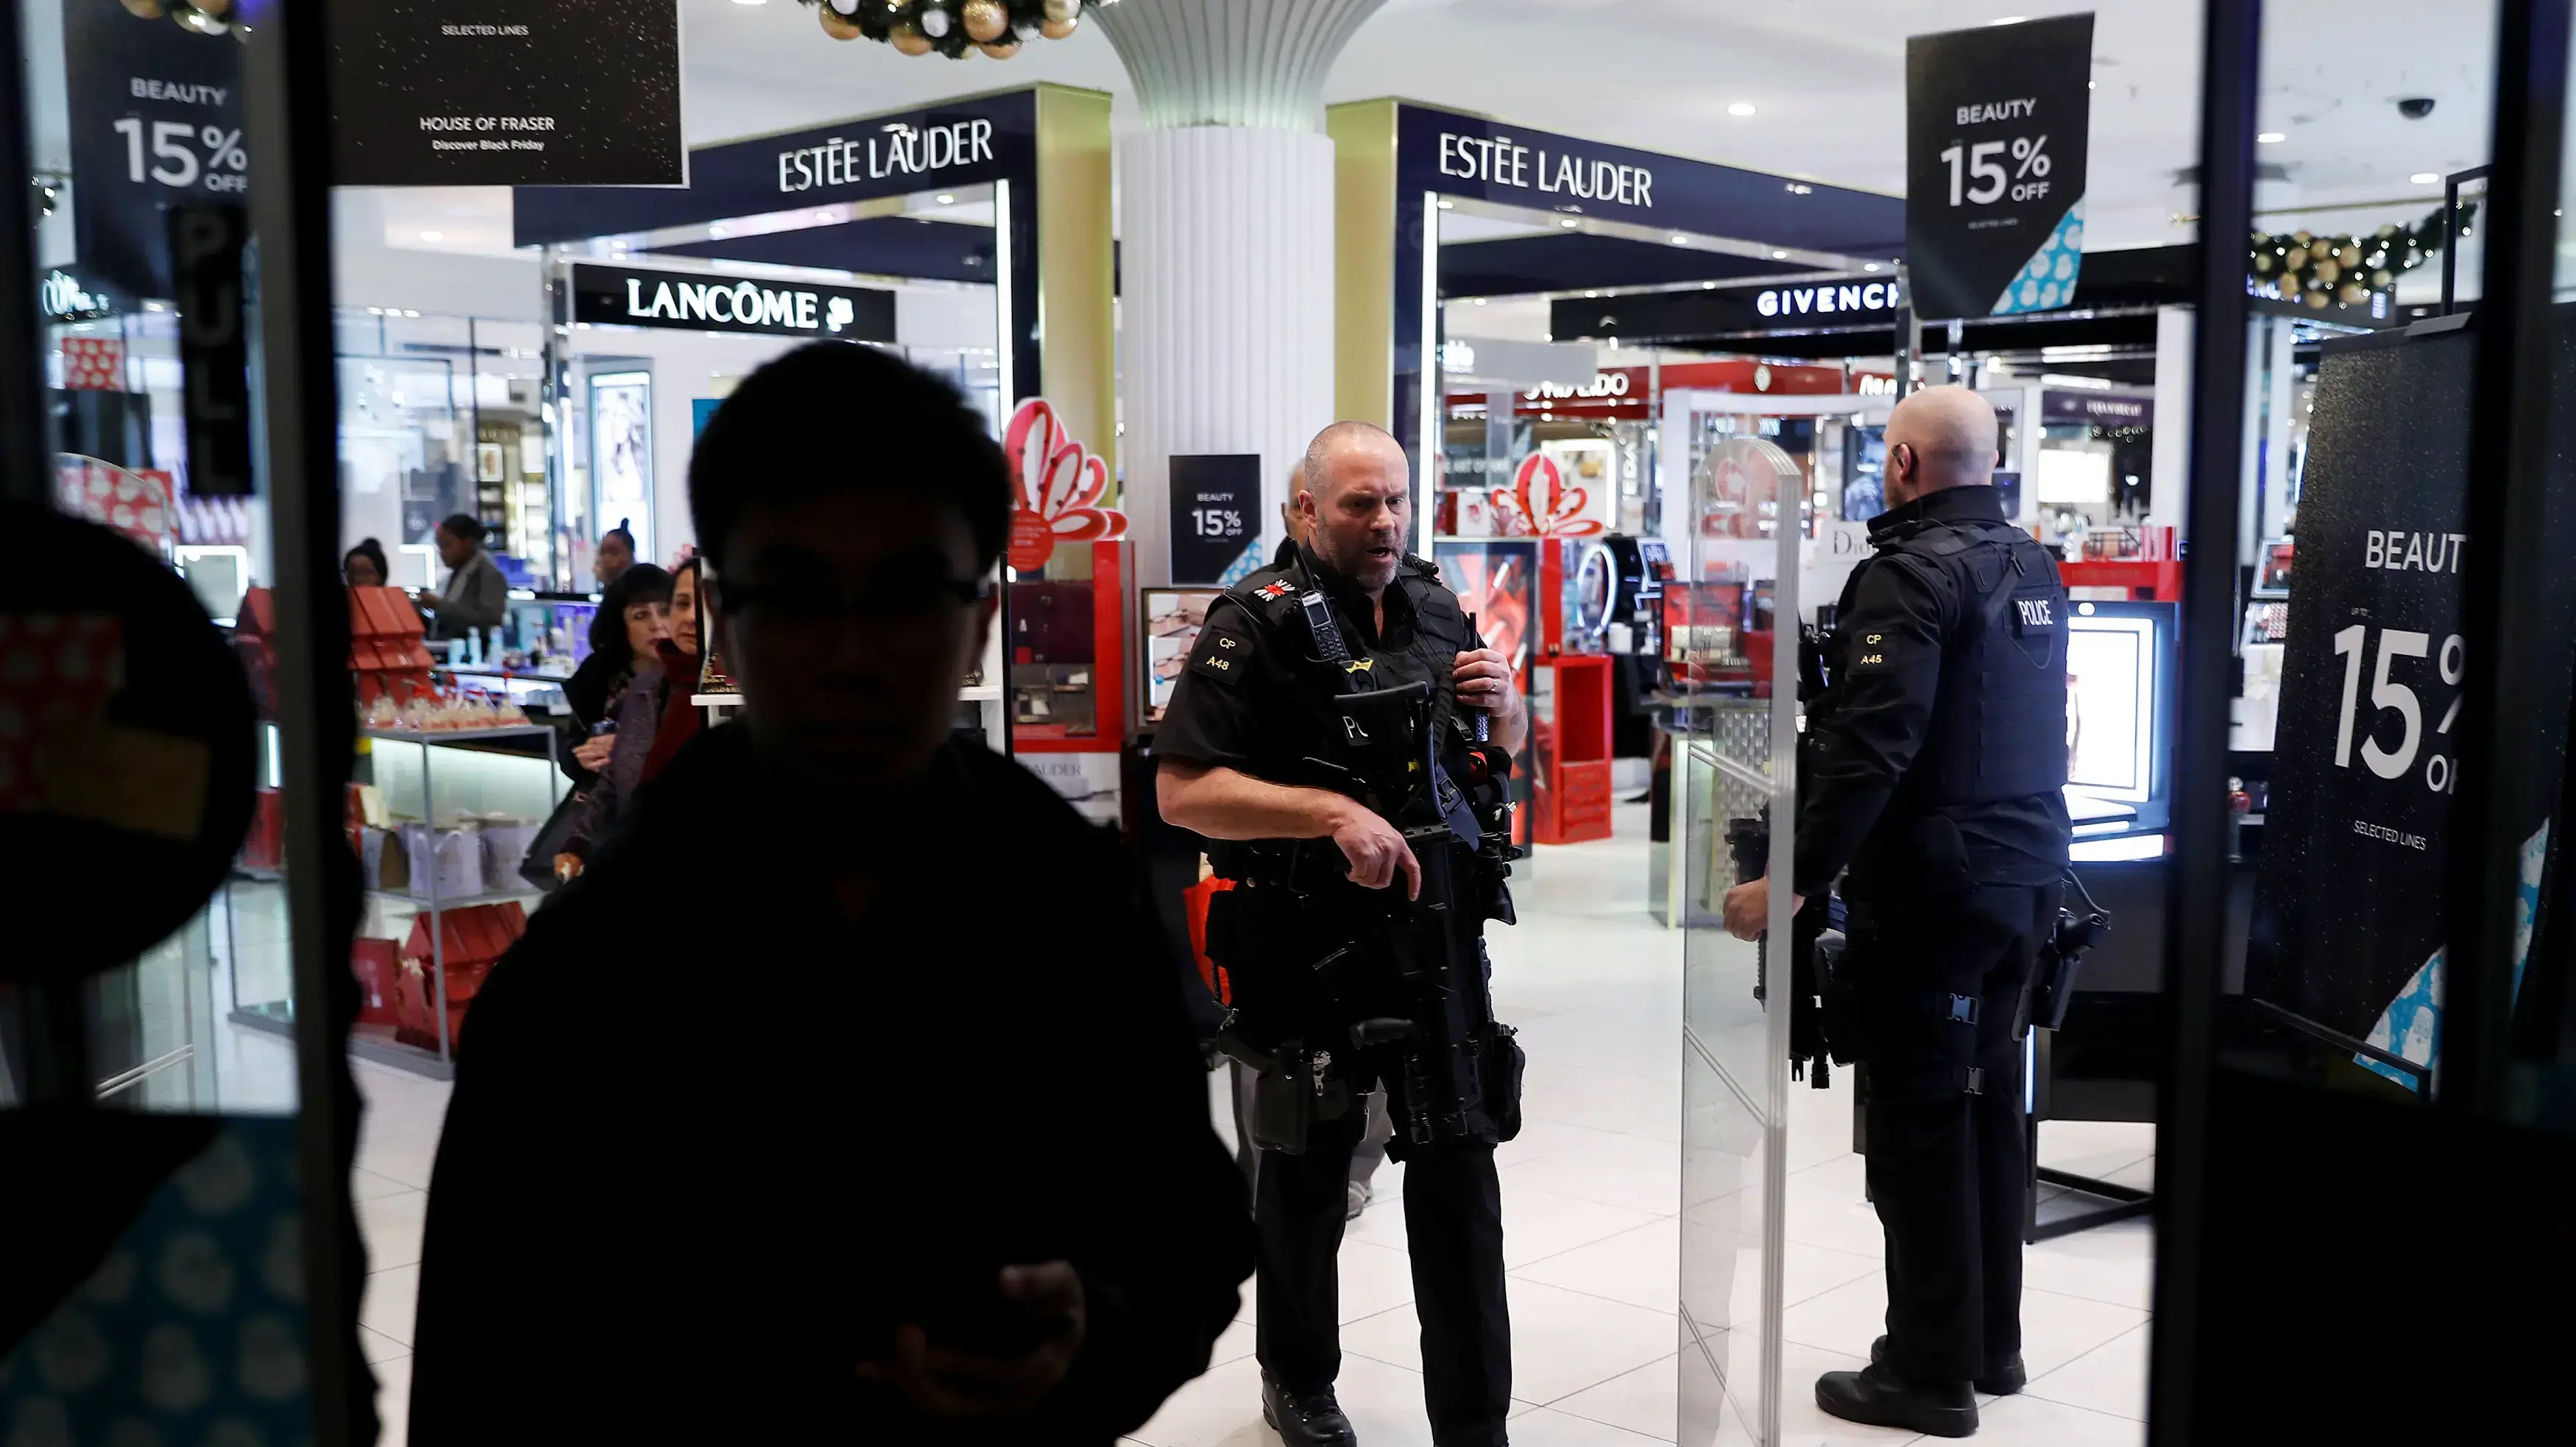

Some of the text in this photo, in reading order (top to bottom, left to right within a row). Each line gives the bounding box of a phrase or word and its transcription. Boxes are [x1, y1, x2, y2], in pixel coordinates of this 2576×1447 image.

[442, 24, 529, 35] SELECTED LINES
[130, 77, 227, 107] BEAUTY
[420, 116, 555, 131] HOUSE OF FRASER
[1956, 97, 2037, 125] BEAUTY
[113, 118, 247, 187] 15%
[432, 139, 545, 152] Discover Black Friday
[868, 118, 994, 179] LAUDER
[205, 172, 247, 193] OFF
[1538, 150, 1652, 208] LAUDER
[1940, 134, 2051, 206] 15%
[2011, 181, 2050, 202] OFF
[626, 278, 819, 329] LANCÔME
[1197, 493, 1234, 501] BEAUTY
[1191, 509, 1242, 536] 15%
[2365, 529, 2467, 574] BEAUT
[2017, 599, 2053, 626] POLICE
[1220, 637, 1236, 649] CP
[1866, 634, 1882, 645] CP
[1206, 656, 1230, 671] A48
[1860, 654, 1883, 665] A45
[2354, 819, 2427, 850] SELECTED LINES
